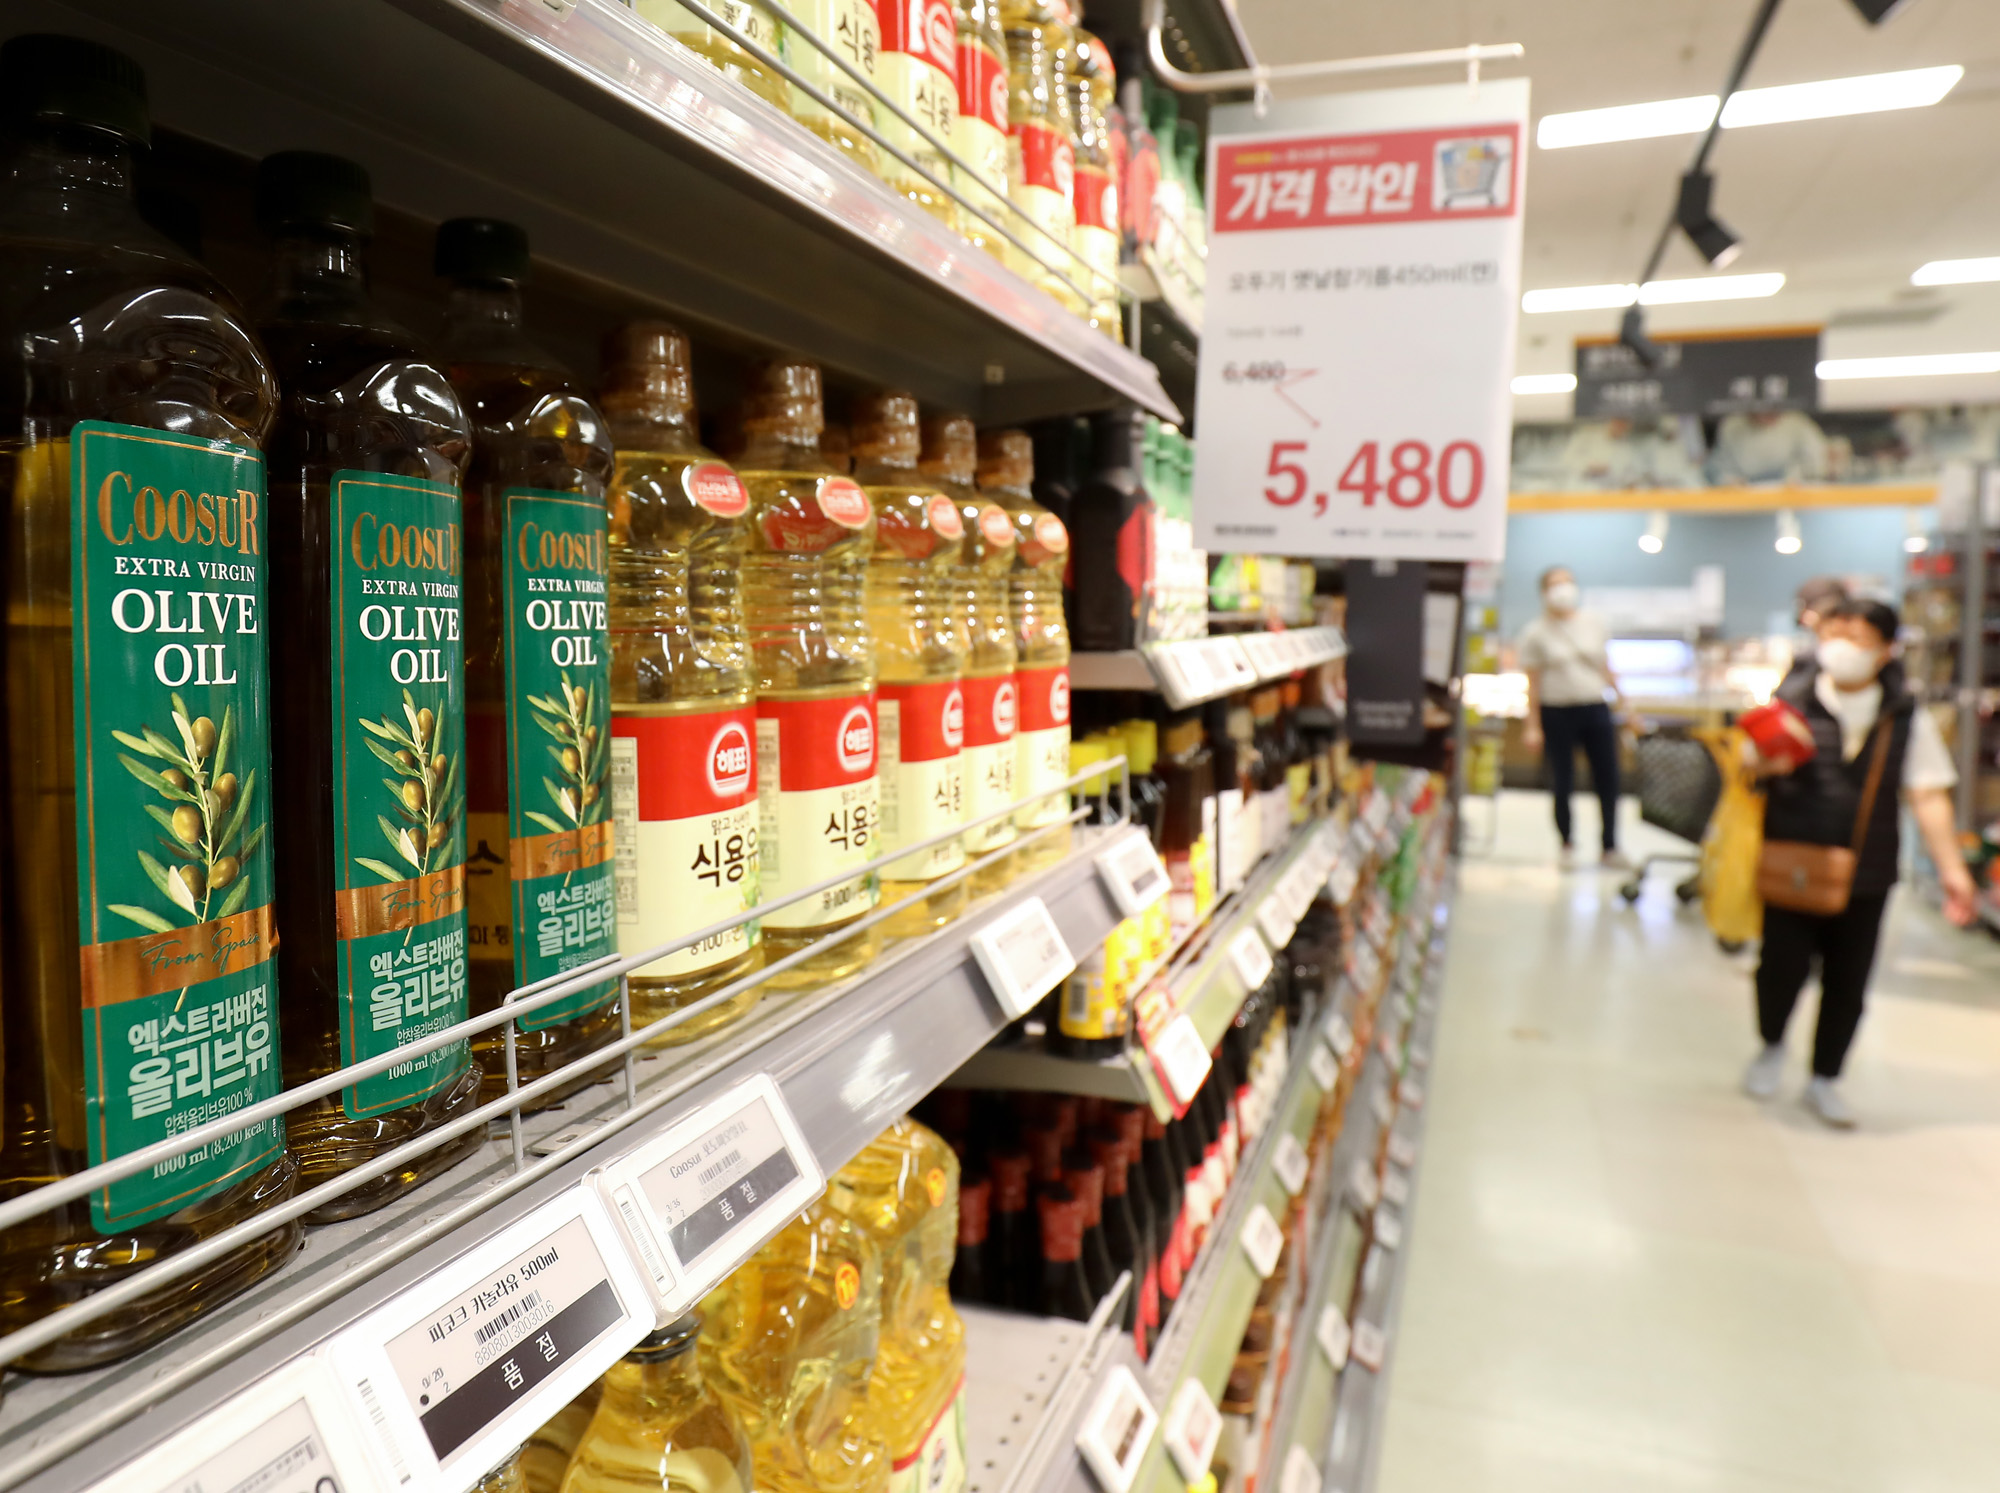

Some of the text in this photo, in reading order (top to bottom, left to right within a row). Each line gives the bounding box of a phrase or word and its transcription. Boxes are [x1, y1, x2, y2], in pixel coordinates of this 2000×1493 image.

[1227, 161, 1419, 221] 가격 할인
[1263, 438, 1486, 519] 5,480
[97, 470, 260, 555] COOSUR
[114, 556, 256, 582] EXTRA VIRGIN
[362, 579, 459, 599] EXTRA VIRGIN
[528, 578, 605, 594] EXTRA VIRGIN
[111, 588, 258, 634] OLIVE
[359, 604, 460, 641] OLIVE
[526, 599, 607, 631] OLIVE
[154, 643, 237, 687] OIL
[390, 648, 448, 684] OIL
[551, 636, 598, 667] OIL
[716, 746, 747, 774] 해표
[537, 873, 613, 916] 엑스트라버진
[537, 899, 615, 958] 올리브유
[141, 939, 206, 976] From
[370, 927, 464, 982] 엑스트라버진
[369, 958, 465, 1032] 올리브유
[127, 984, 267, 1054] 엑스트라버진
[127, 1020, 271, 1120] 올리브유
[414, 1054, 429, 1071] ml
[189, 1146, 209, 1166] ml
[427, 1246, 559, 1344] 피코크 카놀라유 500ml
[501, 1330, 559, 1391] 품 절
